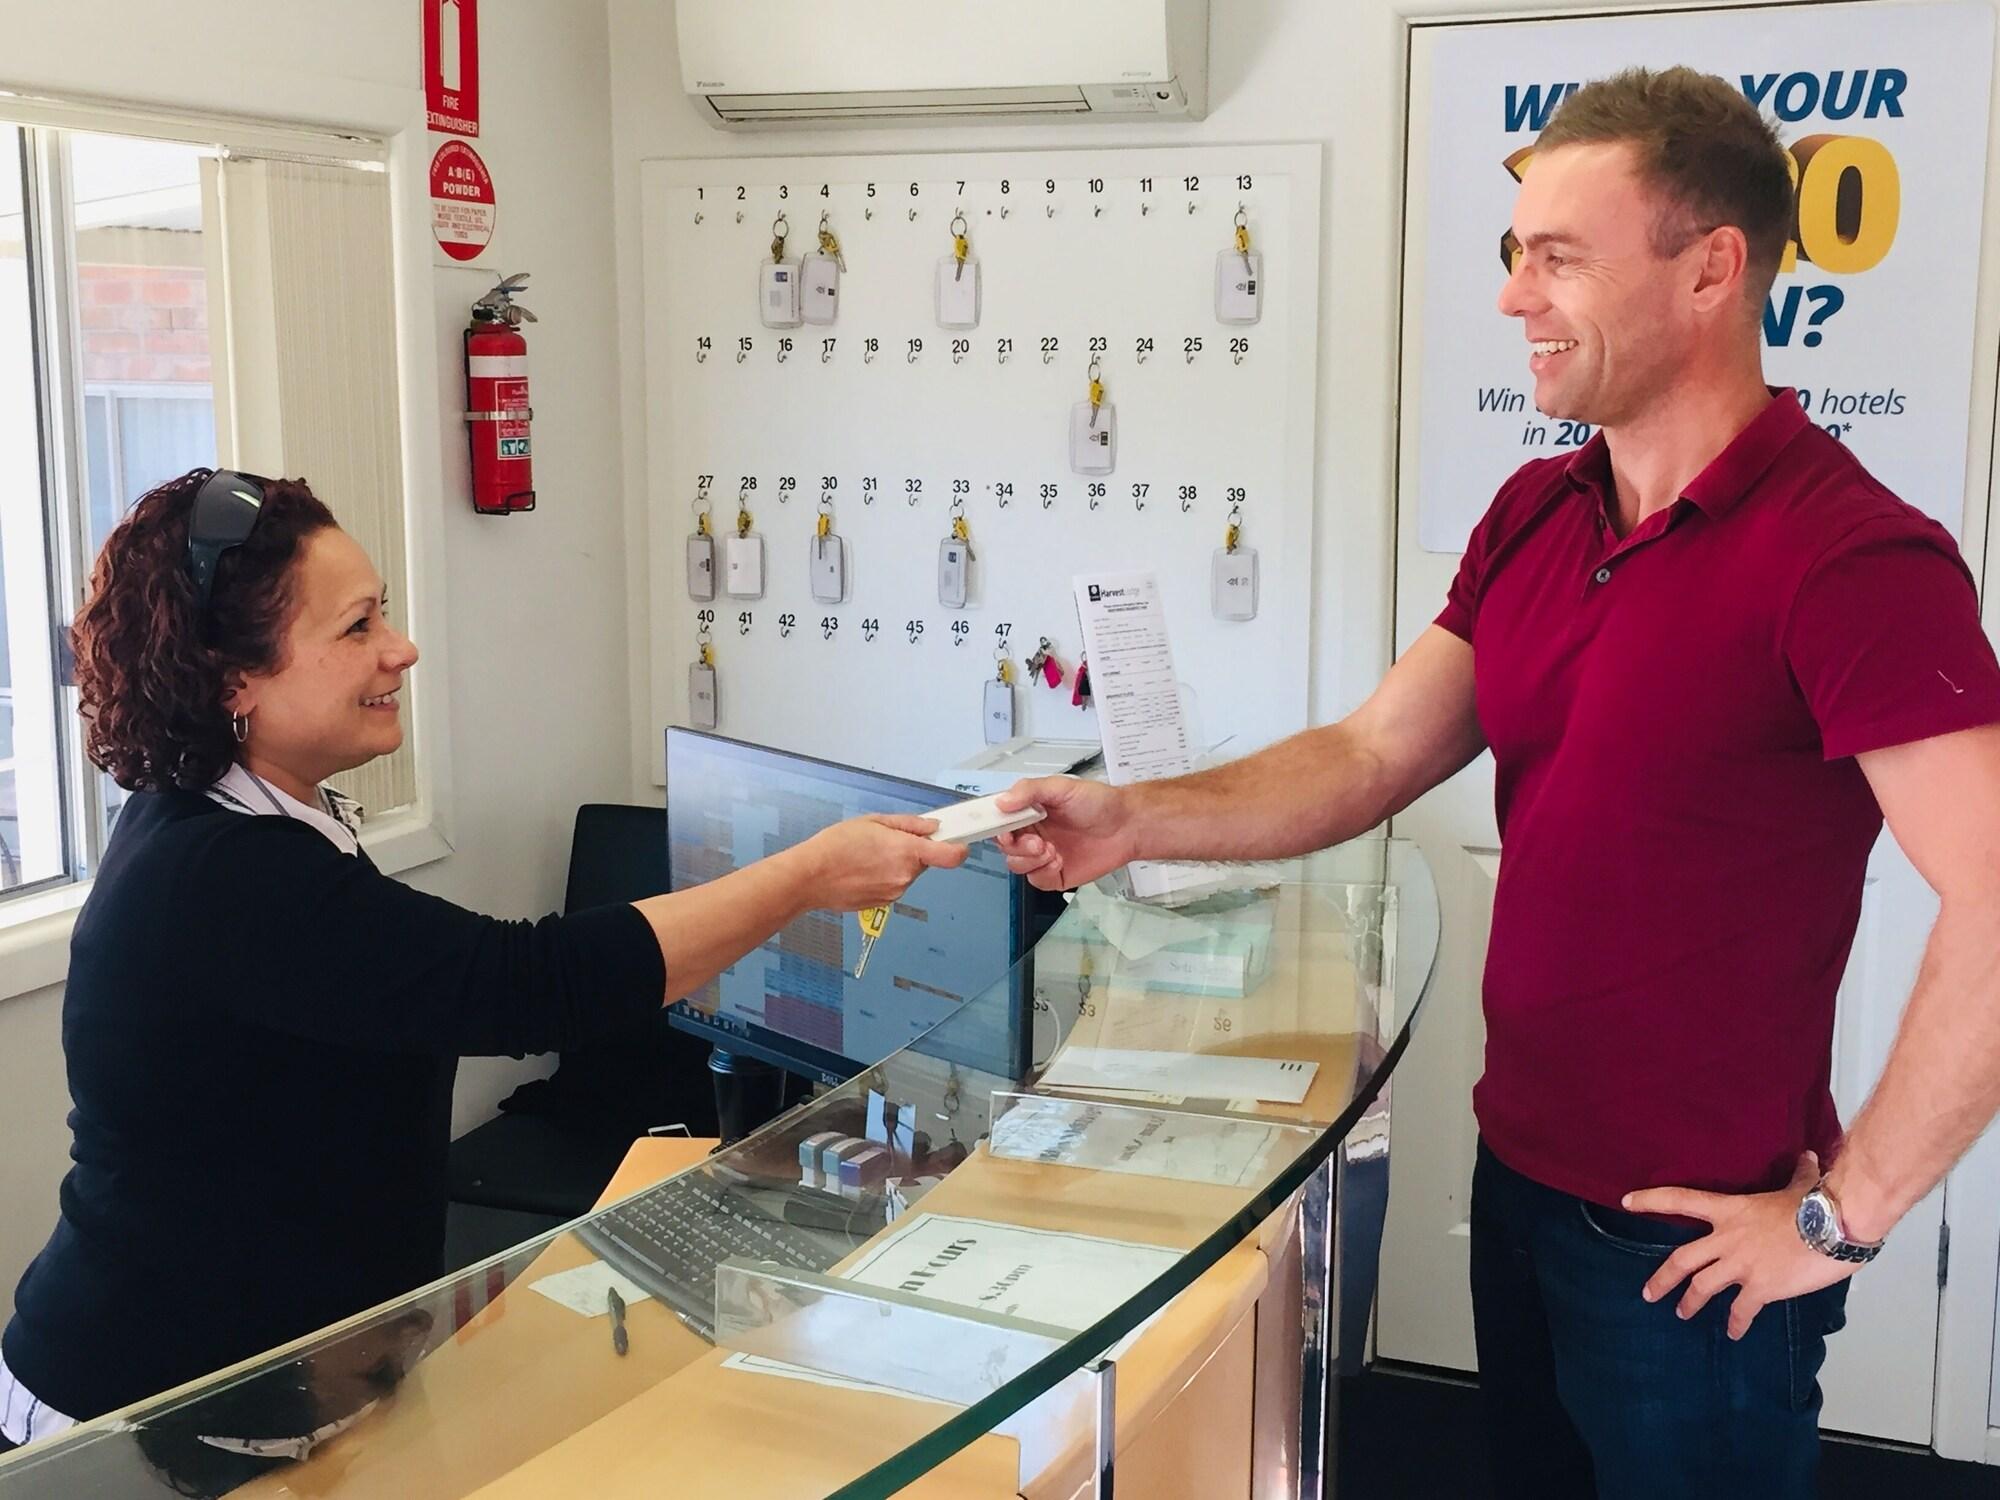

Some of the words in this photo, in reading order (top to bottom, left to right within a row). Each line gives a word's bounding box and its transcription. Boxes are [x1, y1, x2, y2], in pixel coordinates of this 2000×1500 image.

[442, 94, 459, 111] FIRE
[1740, 68, 1908, 122] YOUR
[427, 112, 477, 135] EXTINGUISHER
[442, 181, 481, 198] POWDER
[696, 187, 704, 201] 1
[736, 185, 746, 201] 2
[779, 184, 789, 200] 3
[819, 183, 830, 199] 4
[866, 182, 876, 198] 5
[909, 182, 919, 197] 6
[955, 180, 966, 196] 7
[1000, 179, 1011, 195] 8
[1045, 178, 1056, 194] 9
[1087, 178, 1104, 194] 10
[1139, 177, 1153, 193] 11
[1183, 175, 1200, 191] 12
[1235, 174, 1253, 190] 13
[696, 336, 712, 350] 14
[738, 336, 753, 352] 15
[776, 337, 793, 353] 16
[821, 337, 837, 353] 17
[863, 337, 879, 353] 18
[907, 337, 923, 353] 19
[951, 338, 970, 354] 20
[997, 338, 1013, 354] 21
[1040, 336, 1059, 352] 22
[1088, 336, 1108, 352] 23
[1135, 337, 1155, 353] 24
[1183, 336, 1203, 352] 25
[1229, 337, 1249, 353] 26
[1478, 387, 1525, 413] Win
[1820, 387, 1907, 415] hotels
[1522, 420, 1546, 446] in
[697, 474, 714, 490] 27
[739, 476, 758, 492] 28
[779, 476, 797, 491] 29
[821, 475, 838, 490] 30
[862, 476, 878, 491] 31
[904, 478, 923, 493] 32
[952, 479, 970, 494] 33
[995, 482, 1014, 498] 34
[1039, 483, 1058, 499] 35
[1087, 482, 1107, 498] 36
[1131, 483, 1151, 498] 37
[1178, 485, 1198, 501] 38
[1226, 487, 1246, 502] 39
[696, 609, 715, 625] 40
[738, 611, 753, 627] 41
[778, 613, 796, 628] 42
[820, 616, 839, 632] 43
[861, 618, 880, 634] 44
[905, 620, 925, 636] 45
[950, 620, 970, 635] 46
[994, 623, 1013, 637] 47
